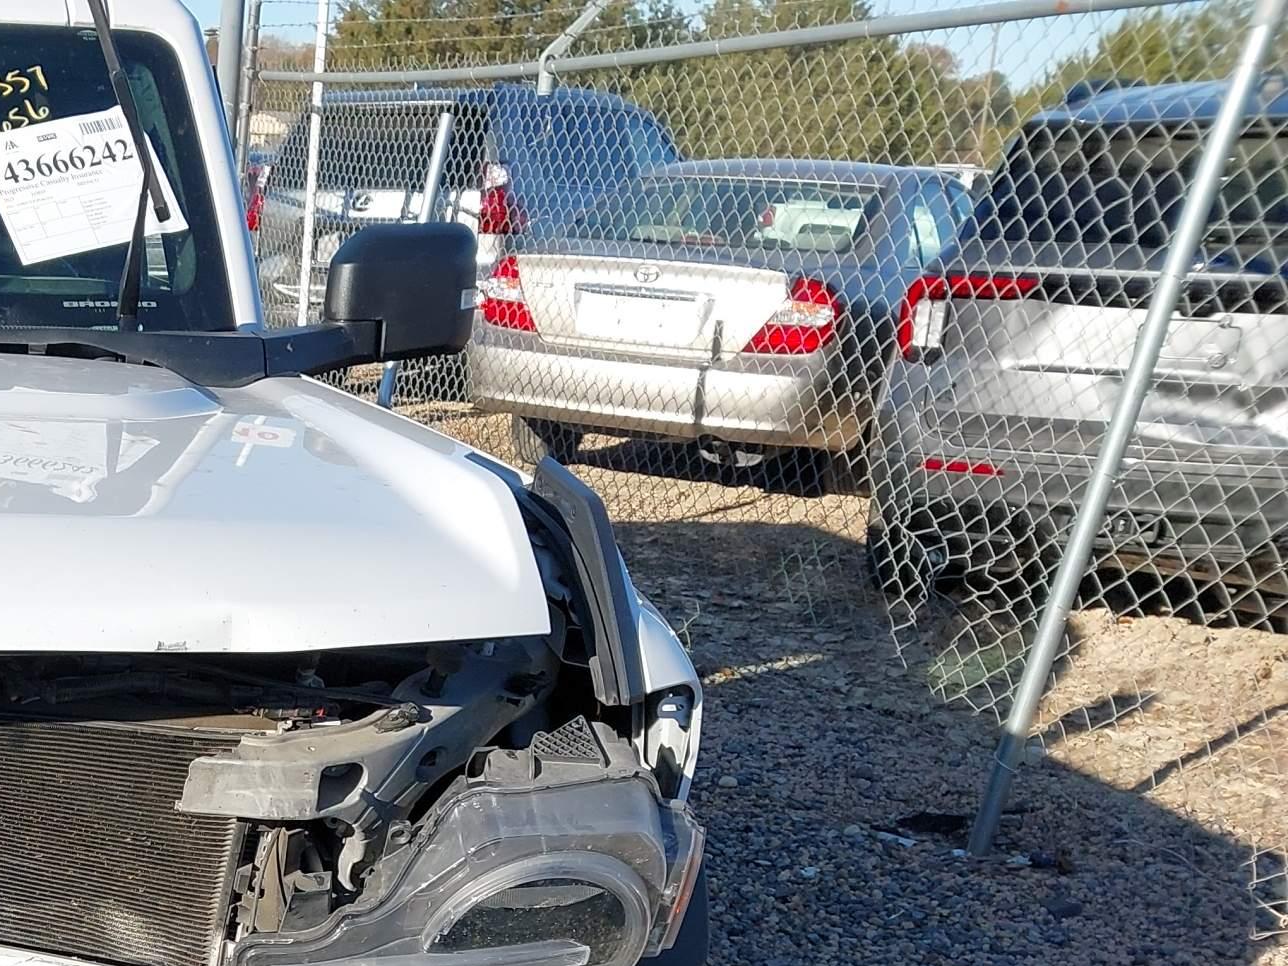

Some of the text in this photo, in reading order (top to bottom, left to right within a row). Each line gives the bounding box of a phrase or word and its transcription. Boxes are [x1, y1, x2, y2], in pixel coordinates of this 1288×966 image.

[3, 138, 134, 184] 43666242
[0, 181, 39, 196] Progressive
[71, 168, 104, 181] Insurance
[63, 300, 157, 308] BROO
